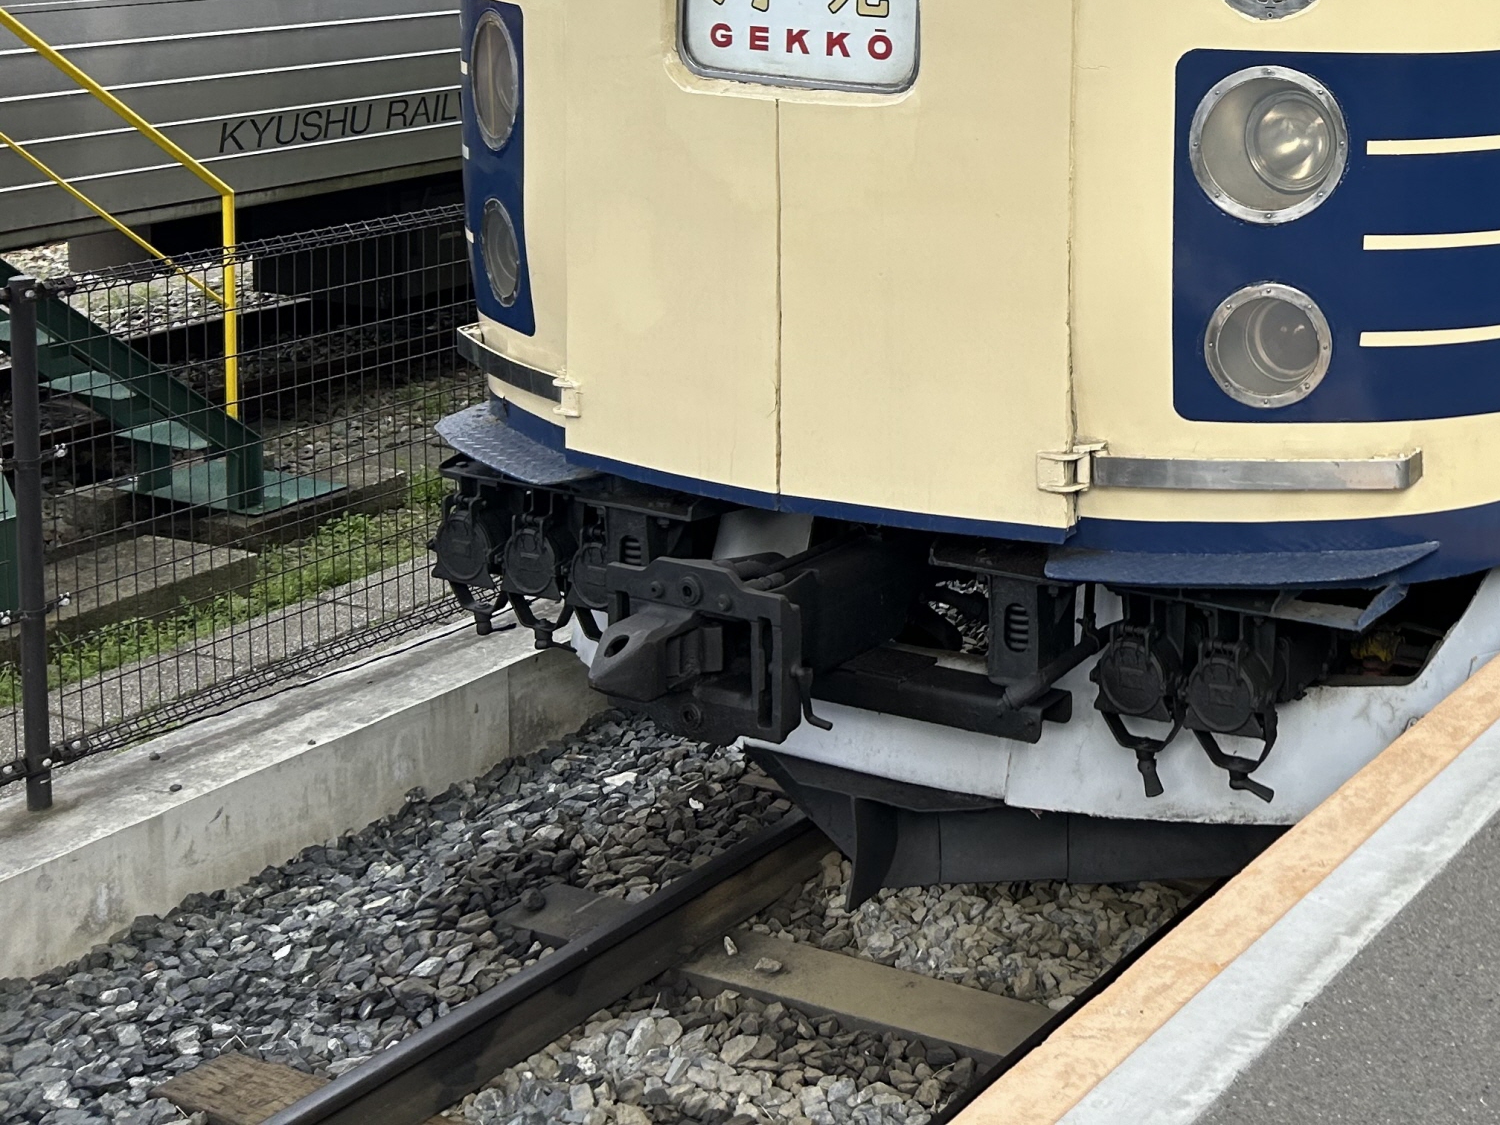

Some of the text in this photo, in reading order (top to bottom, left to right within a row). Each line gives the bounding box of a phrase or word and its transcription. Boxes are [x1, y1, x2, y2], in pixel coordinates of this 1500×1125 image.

[710, 22, 893, 61] GEKKŌ
[219, 91, 462, 153] KYUSHU RAIL
